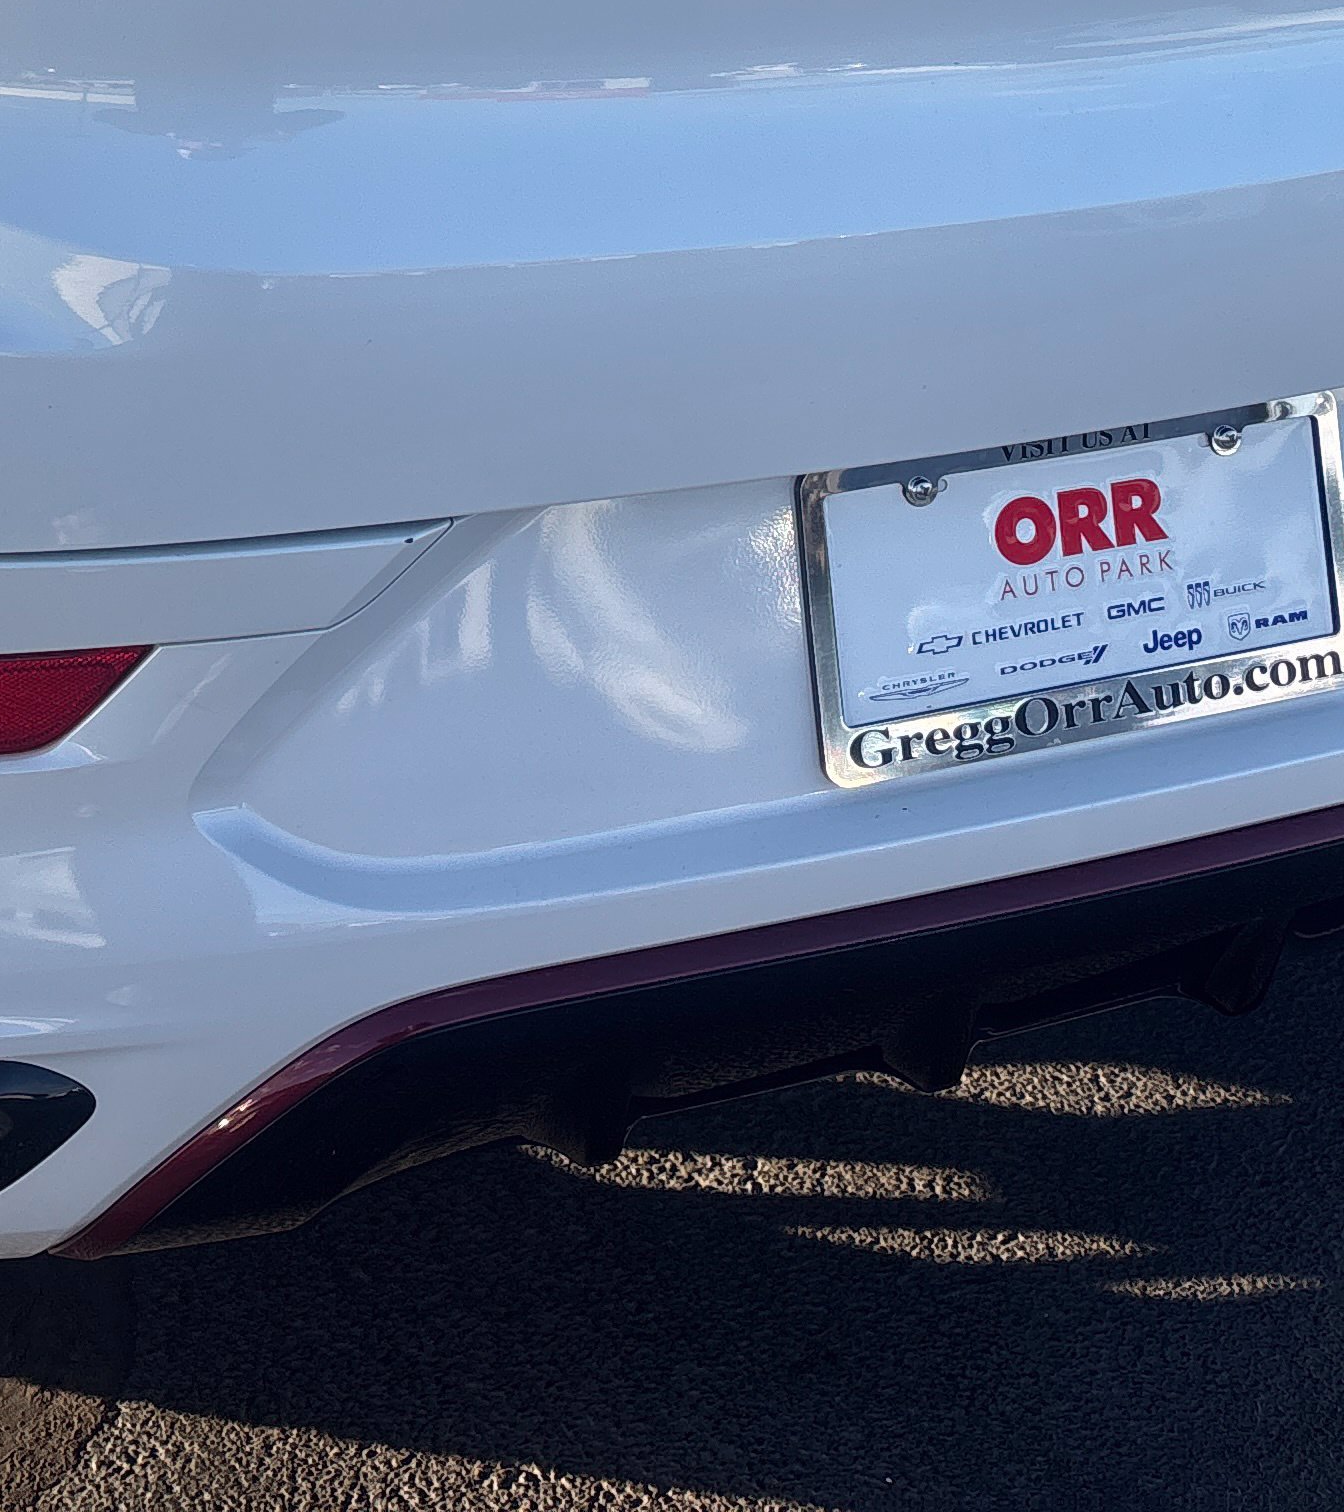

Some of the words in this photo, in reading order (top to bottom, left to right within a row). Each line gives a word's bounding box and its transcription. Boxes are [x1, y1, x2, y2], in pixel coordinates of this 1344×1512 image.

[1001, 435, 1069, 463] VISIT
[1081, 430, 1113, 450] US
[994, 477, 1170, 567] ORR
[1000, 564, 1086, 602] AUTO
[1099, 549, 1175, 585] PARK
[1212, 579, 1267, 598] BUICK
[1106, 596, 1166, 621] GMC
[1254, 609, 1309, 631] RAM
[971, 611, 1085, 647] CHEVROLET
[1142, 625, 1203, 654] Jeep
[1000, 650, 1092, 676] DODGE
[881, 670, 956, 692] CHRYSLER
[849, 648, 1344, 769] GreggOrrAuto.com
